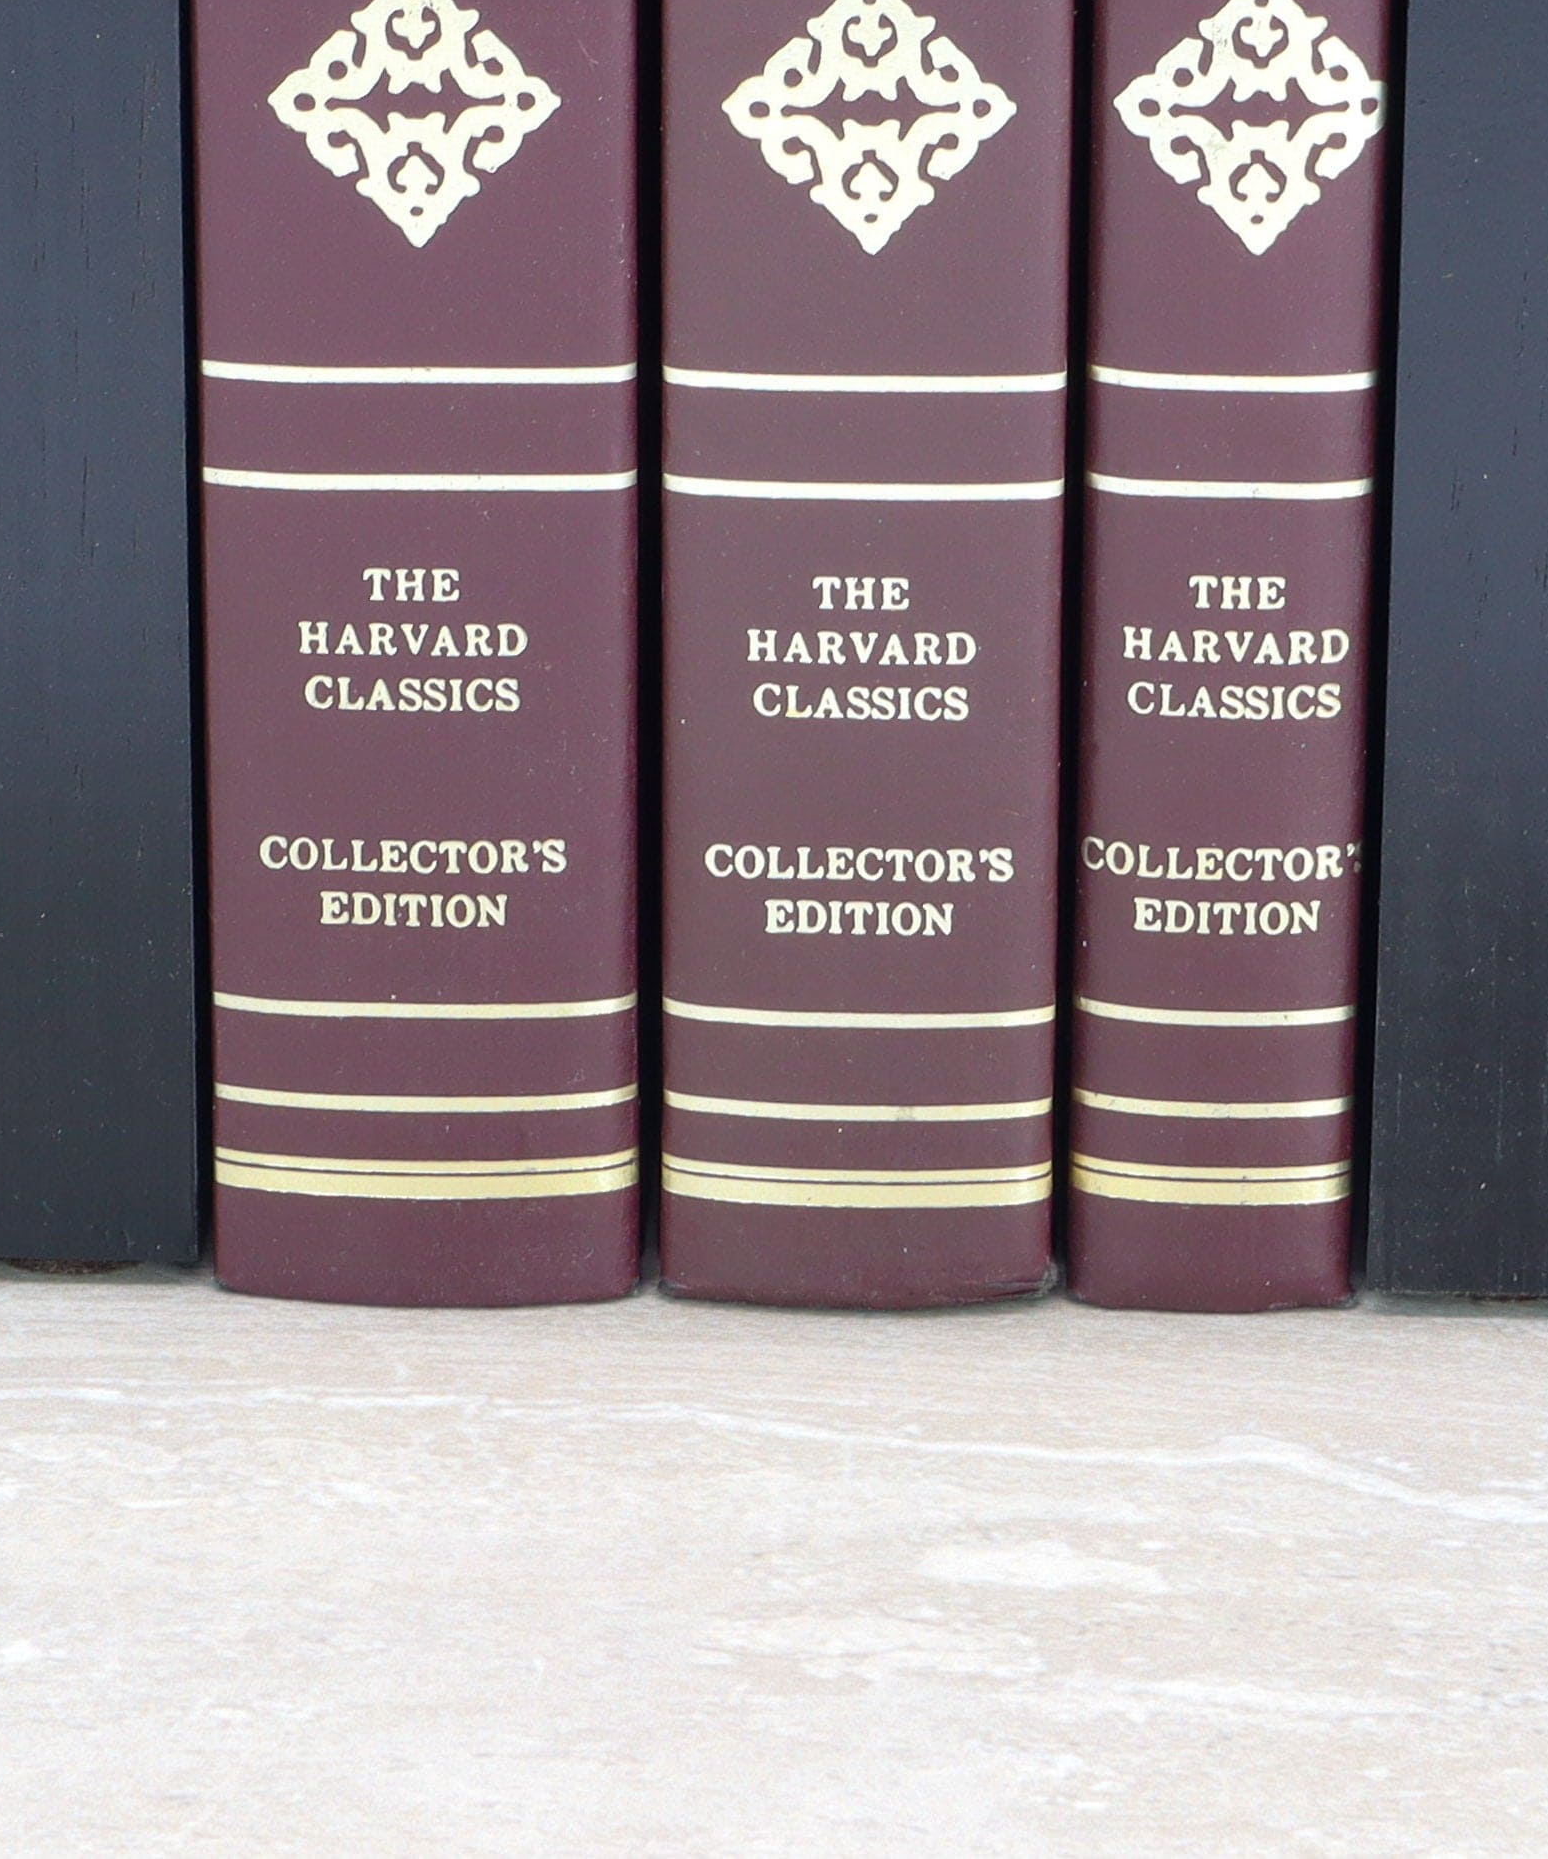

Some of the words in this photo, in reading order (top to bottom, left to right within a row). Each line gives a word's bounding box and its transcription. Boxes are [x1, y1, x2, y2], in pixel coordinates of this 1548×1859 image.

[362, 567, 460, 603] THE
[812, 574, 911, 612] THE
[1188, 574, 1287, 611] THE
[297, 620, 529, 658] HARVARD
[746, 627, 979, 667] HARVARD
[1122, 625, 1350, 668] HARVARD
[304, 674, 521, 713] CLASSICS
[752, 679, 970, 722] CLASSICS
[1127, 680, 1342, 722] CLASSICS
[259, 834, 568, 875] COLLECTOR'S
[704, 843, 1014, 884] COLLECTOR'S
[319, 890, 508, 929] EDITION
[764, 898, 955, 938] EDITION
[1133, 896, 1321, 936] EDITION
